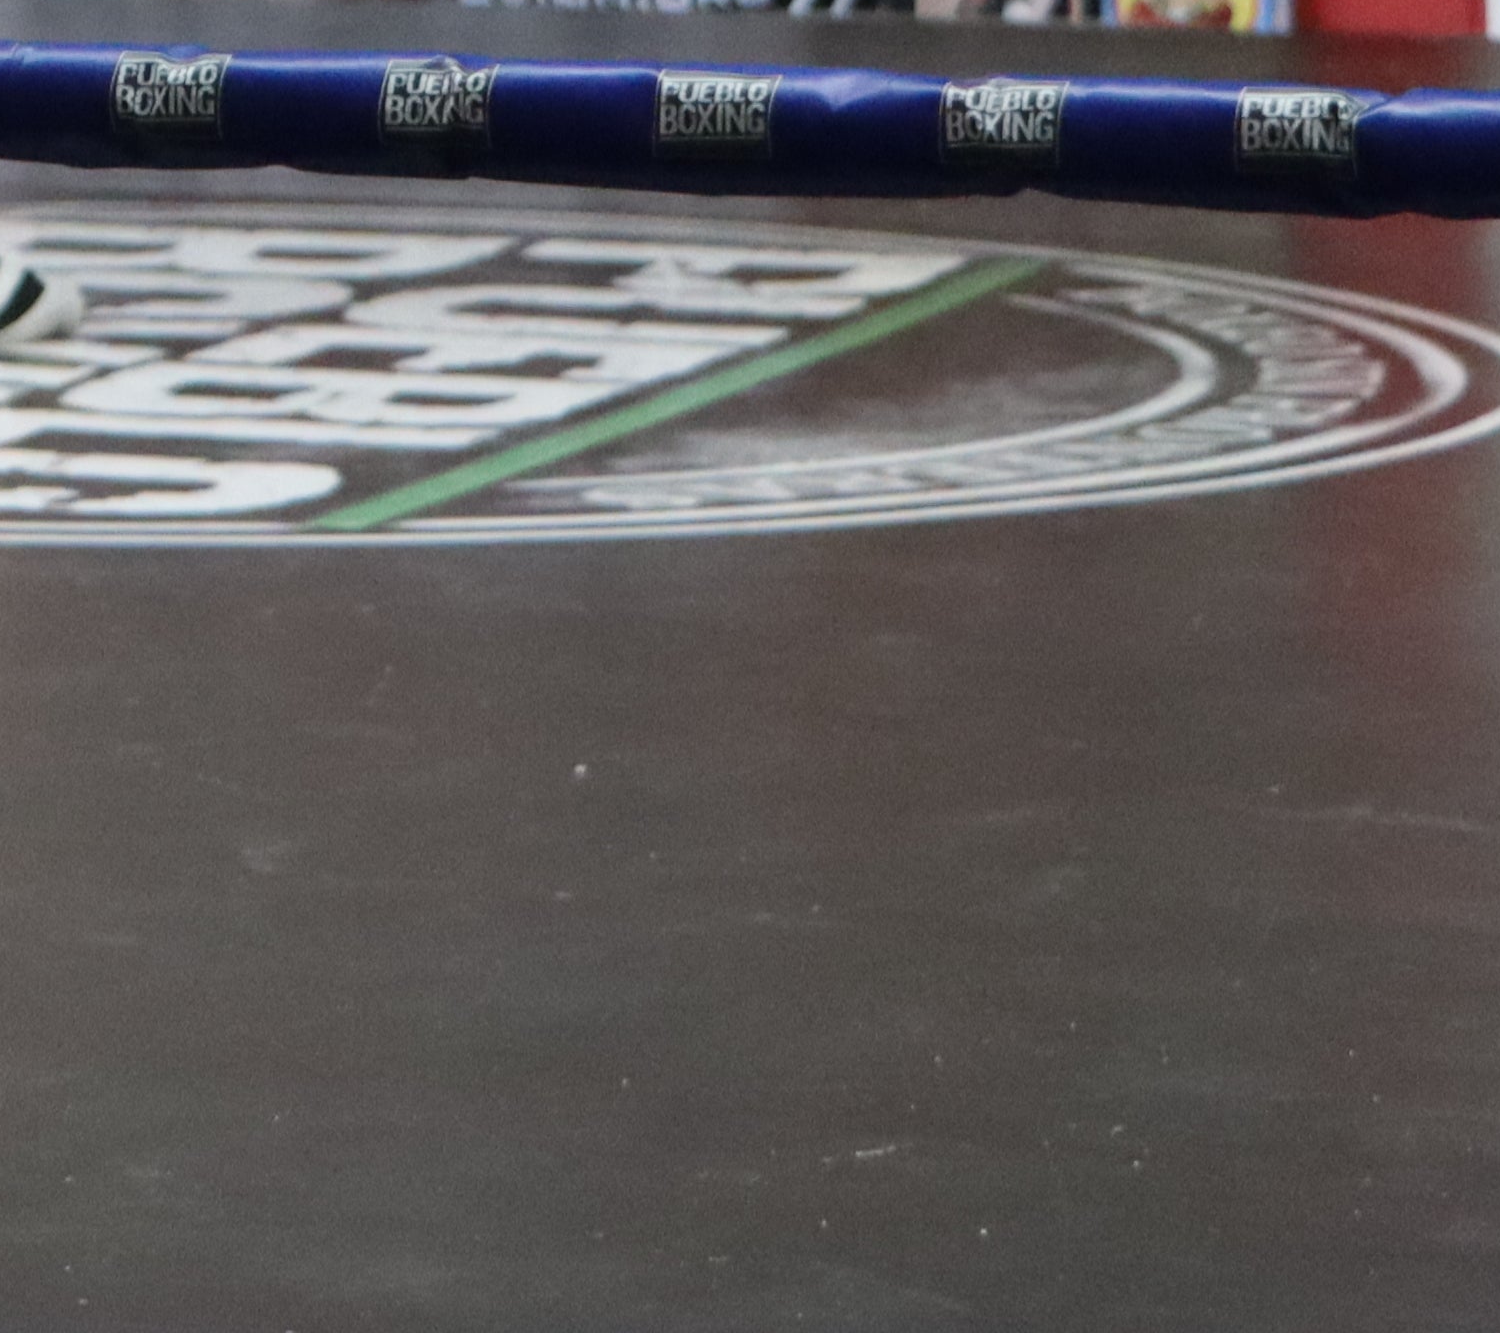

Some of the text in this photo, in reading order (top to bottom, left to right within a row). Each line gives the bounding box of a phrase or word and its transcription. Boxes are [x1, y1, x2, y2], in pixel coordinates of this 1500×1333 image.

[119, 62, 217, 84] PUEBLO
[117, 85, 216, 115] BOXING
[662, 81, 767, 103] PUEBLO
[948, 87, 1054, 109] PUEBLO
[662, 103, 765, 135] BOXING
[949, 109, 1052, 142] BOXING
[1244, 118, 1349, 150] BOXING
